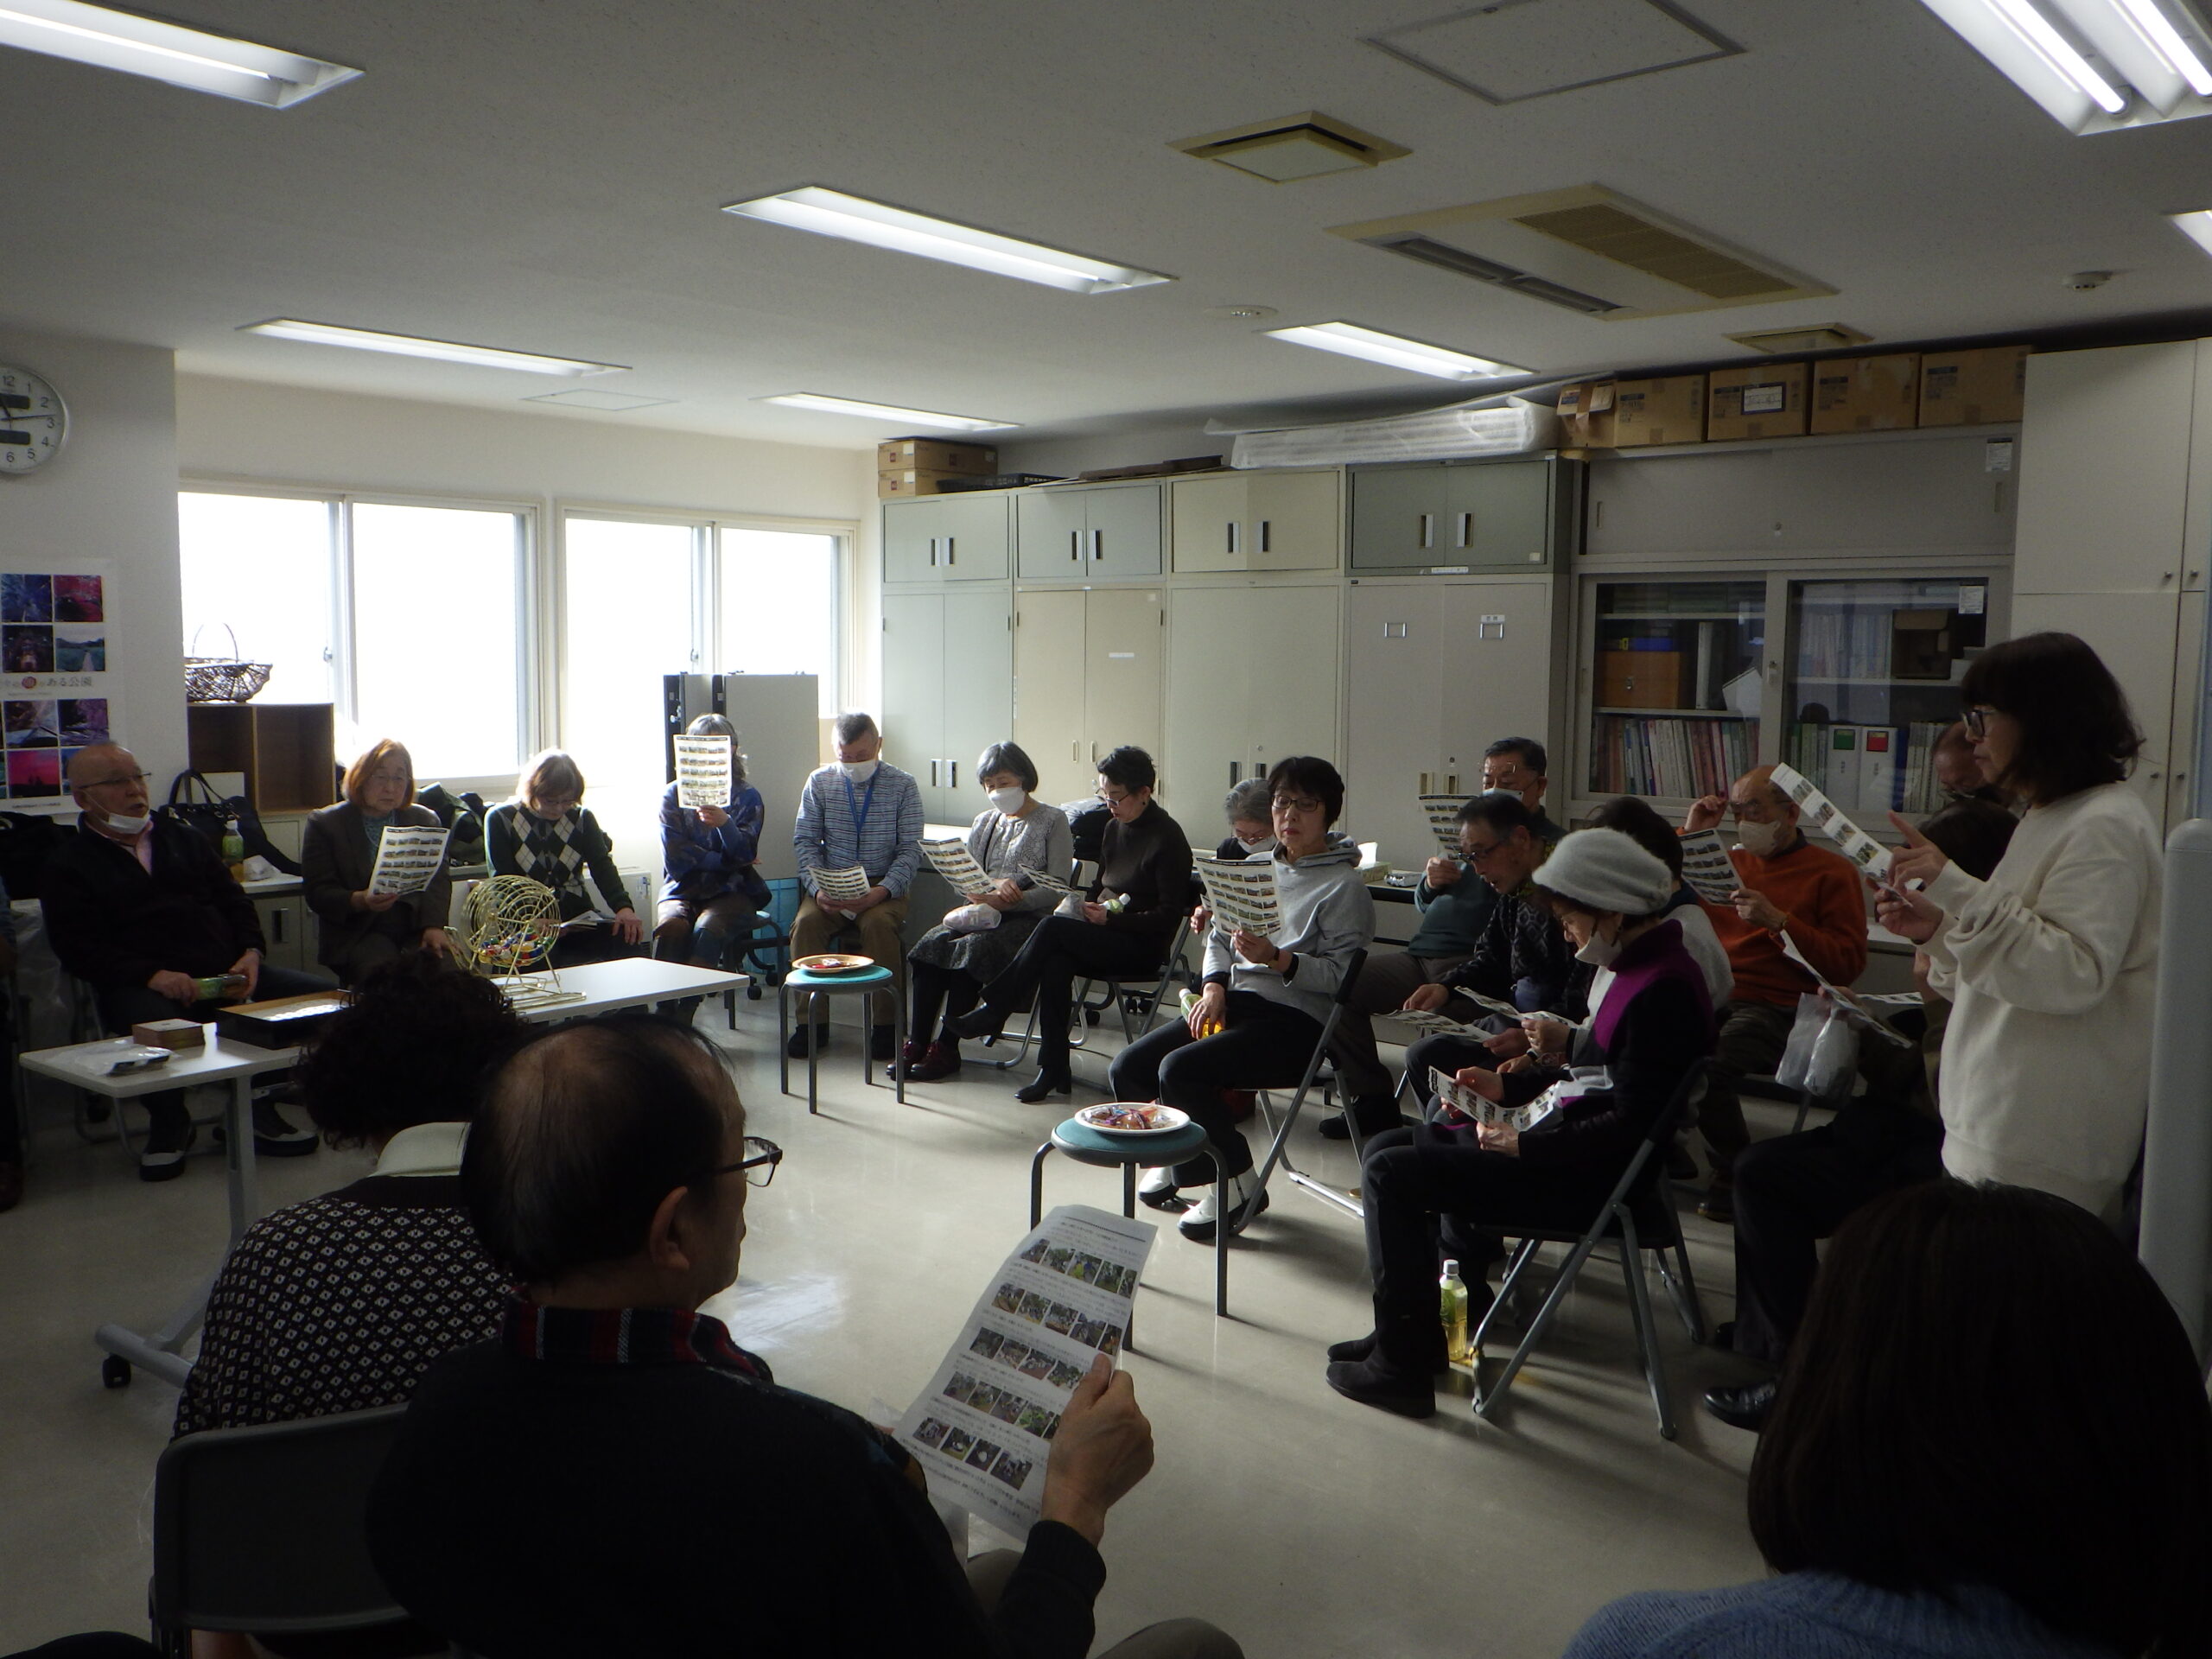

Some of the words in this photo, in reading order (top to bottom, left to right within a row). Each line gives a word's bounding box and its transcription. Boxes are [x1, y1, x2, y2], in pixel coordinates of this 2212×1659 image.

[3, 375, 16, 387] 12
[27, 381, 31, 392] 1
[41, 396, 49, 409] 2
[47, 417, 55, 429] 3
[41, 436, 49, 448] 4
[6, 451, 15, 463] 6
[27, 448, 35, 460] 5
